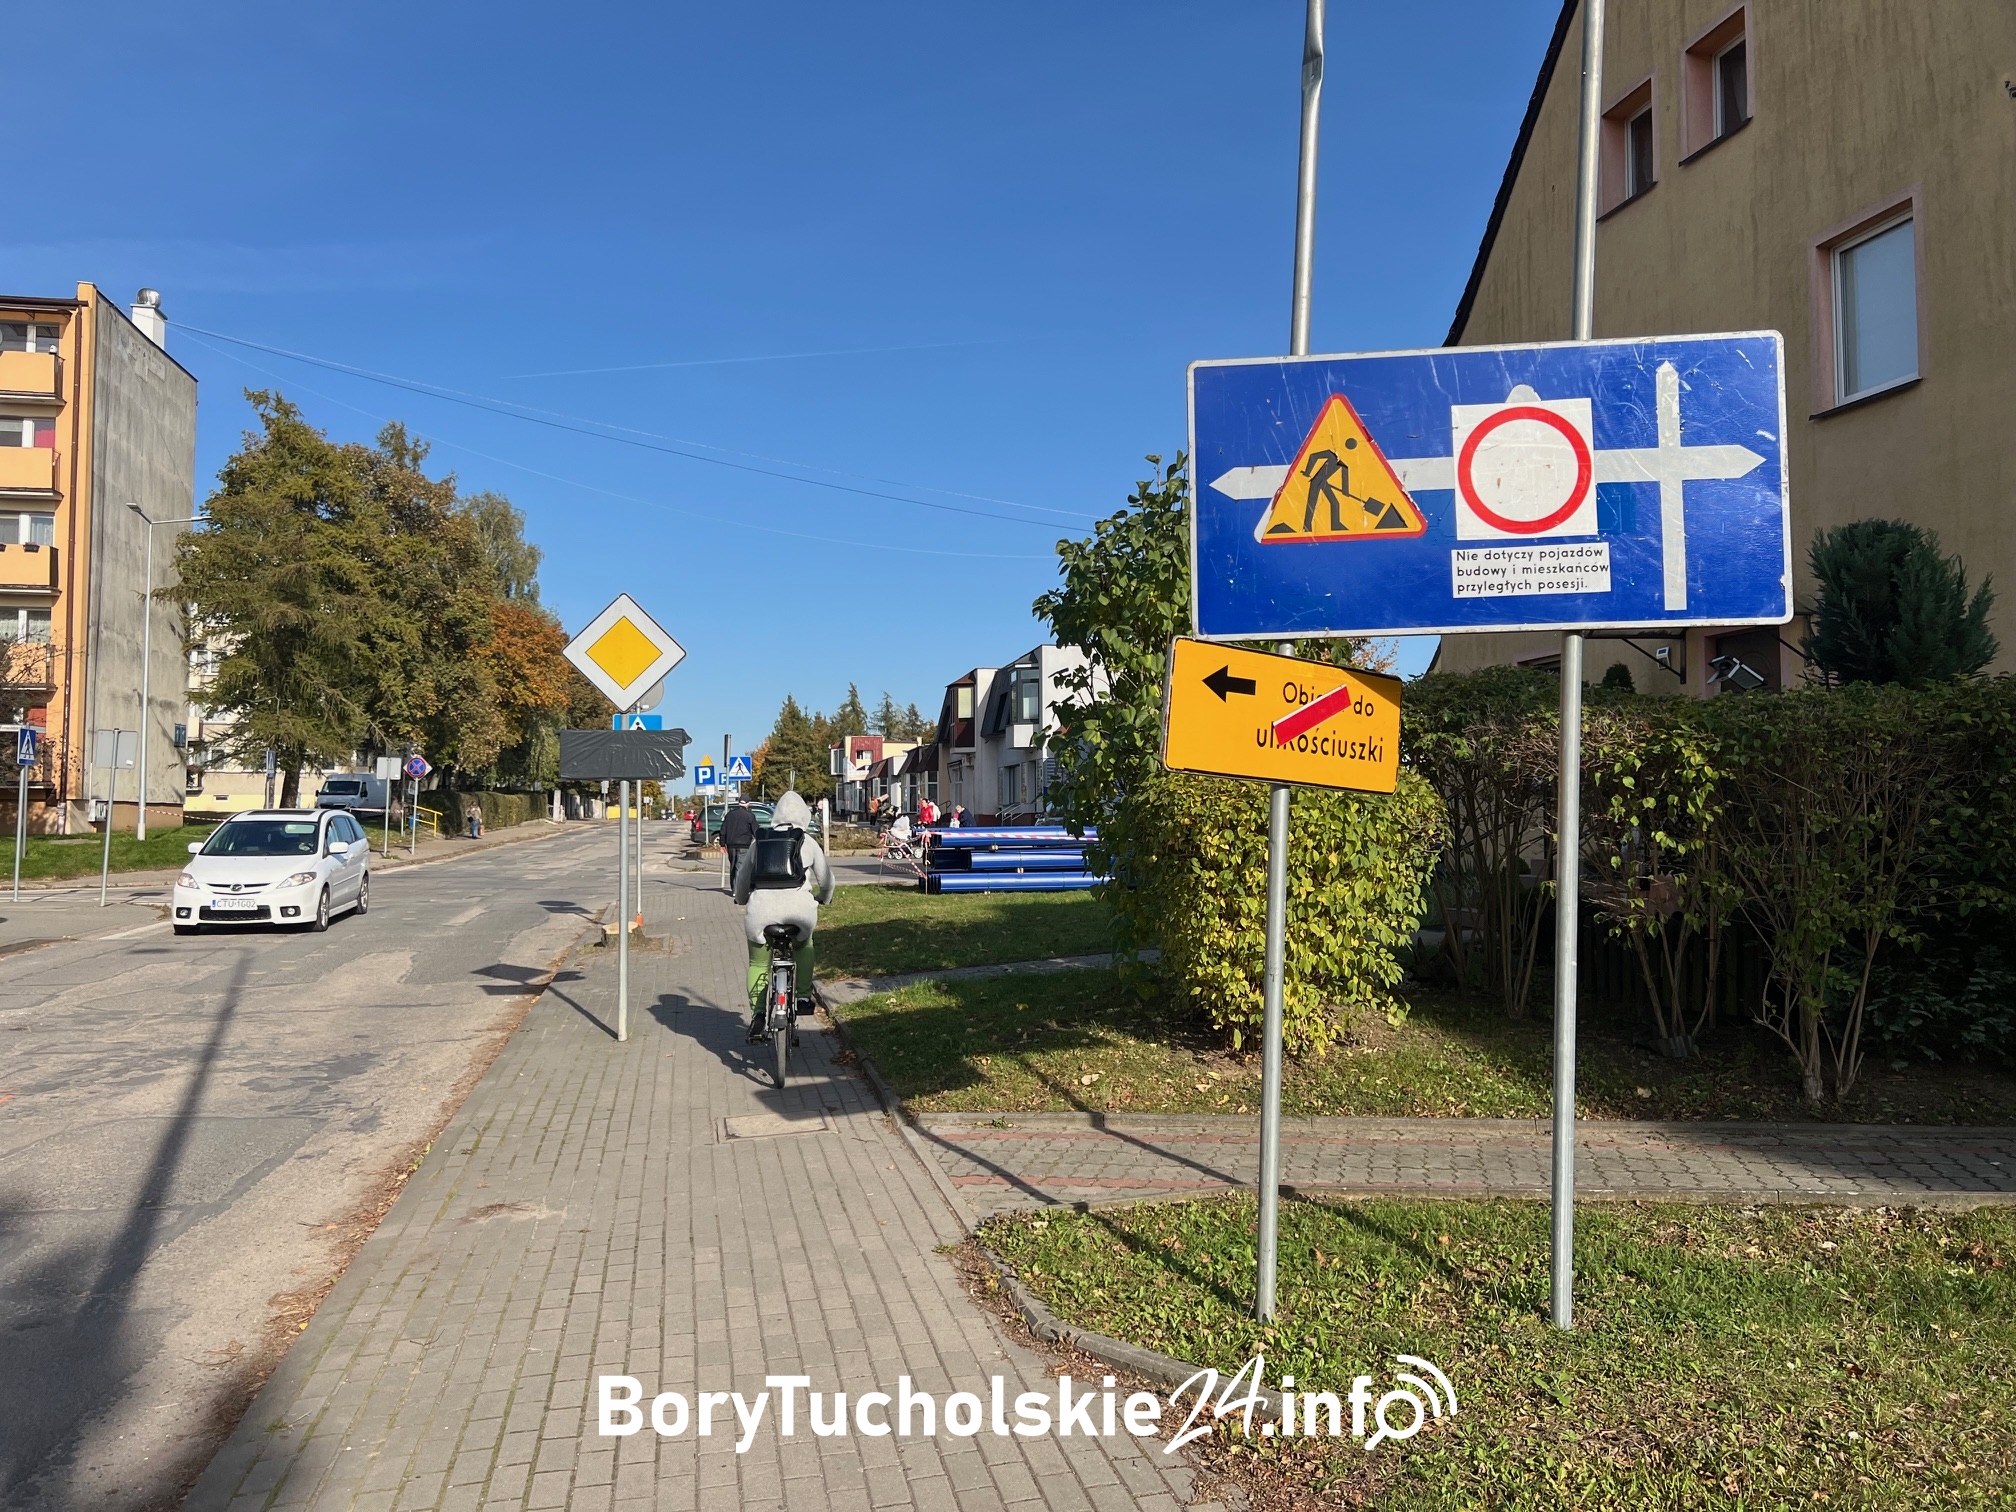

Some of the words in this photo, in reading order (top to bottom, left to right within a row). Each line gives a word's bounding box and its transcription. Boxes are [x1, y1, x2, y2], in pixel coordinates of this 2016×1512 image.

[1456, 550, 1479, 562] Nie
[1484, 549, 1534, 563] dotyczy
[1539, 546, 1604, 561] pojazdów
[1456, 565, 1507, 579] budowy
[1512, 564, 1516, 575] i
[1522, 562, 1609, 576] mieszkańców
[1457, 579, 1532, 595] przyległych
[1538, 577, 1588, 593] posesji.
[1353, 694, 1375, 717] do
[698, 768, 711, 784] P
